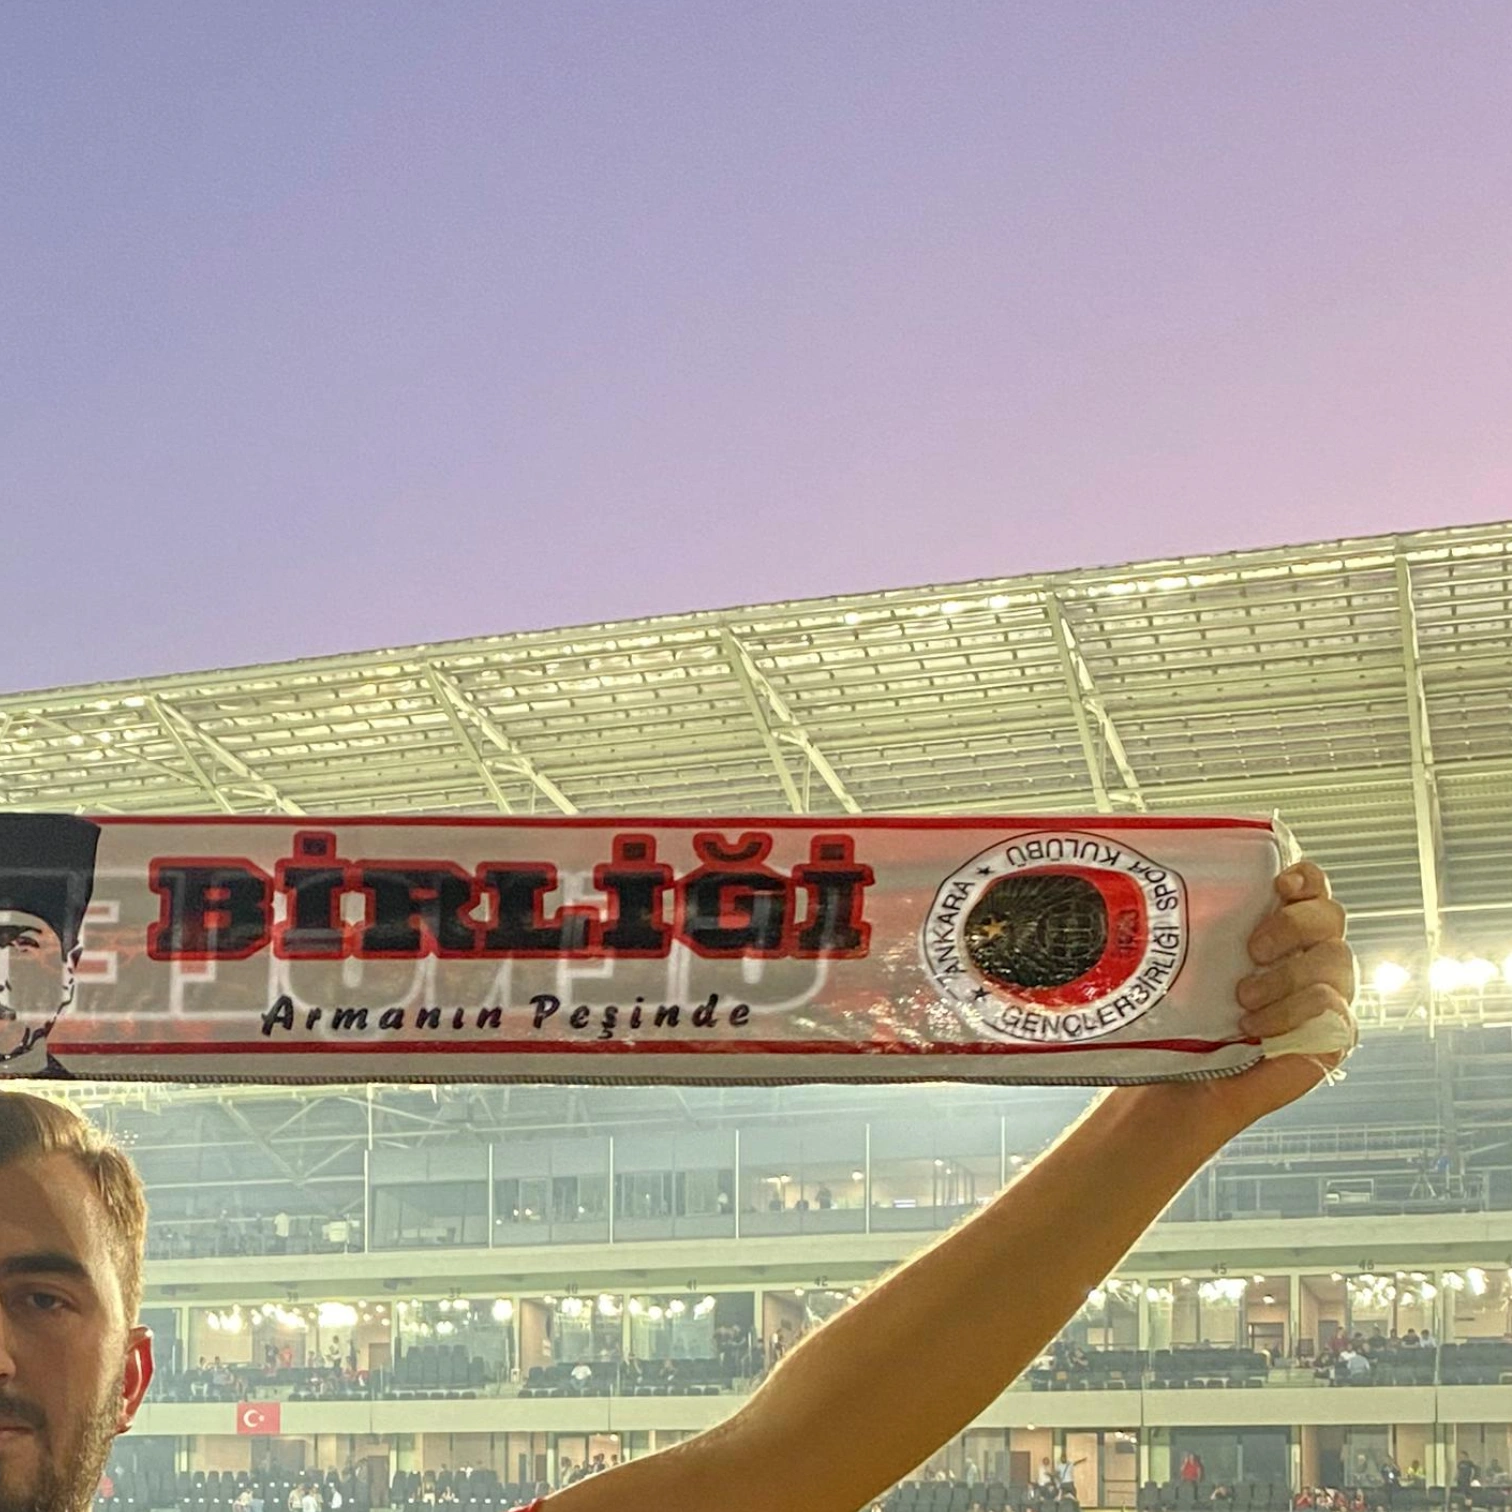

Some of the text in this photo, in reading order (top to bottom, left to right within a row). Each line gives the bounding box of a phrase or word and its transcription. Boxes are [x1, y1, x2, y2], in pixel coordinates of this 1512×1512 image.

[1006, 838, 1121, 867] KULÜBÜ
[147, 831, 875, 960] BİRLİĞİ
[261, 992, 751, 1039] Armanın Peşinde
